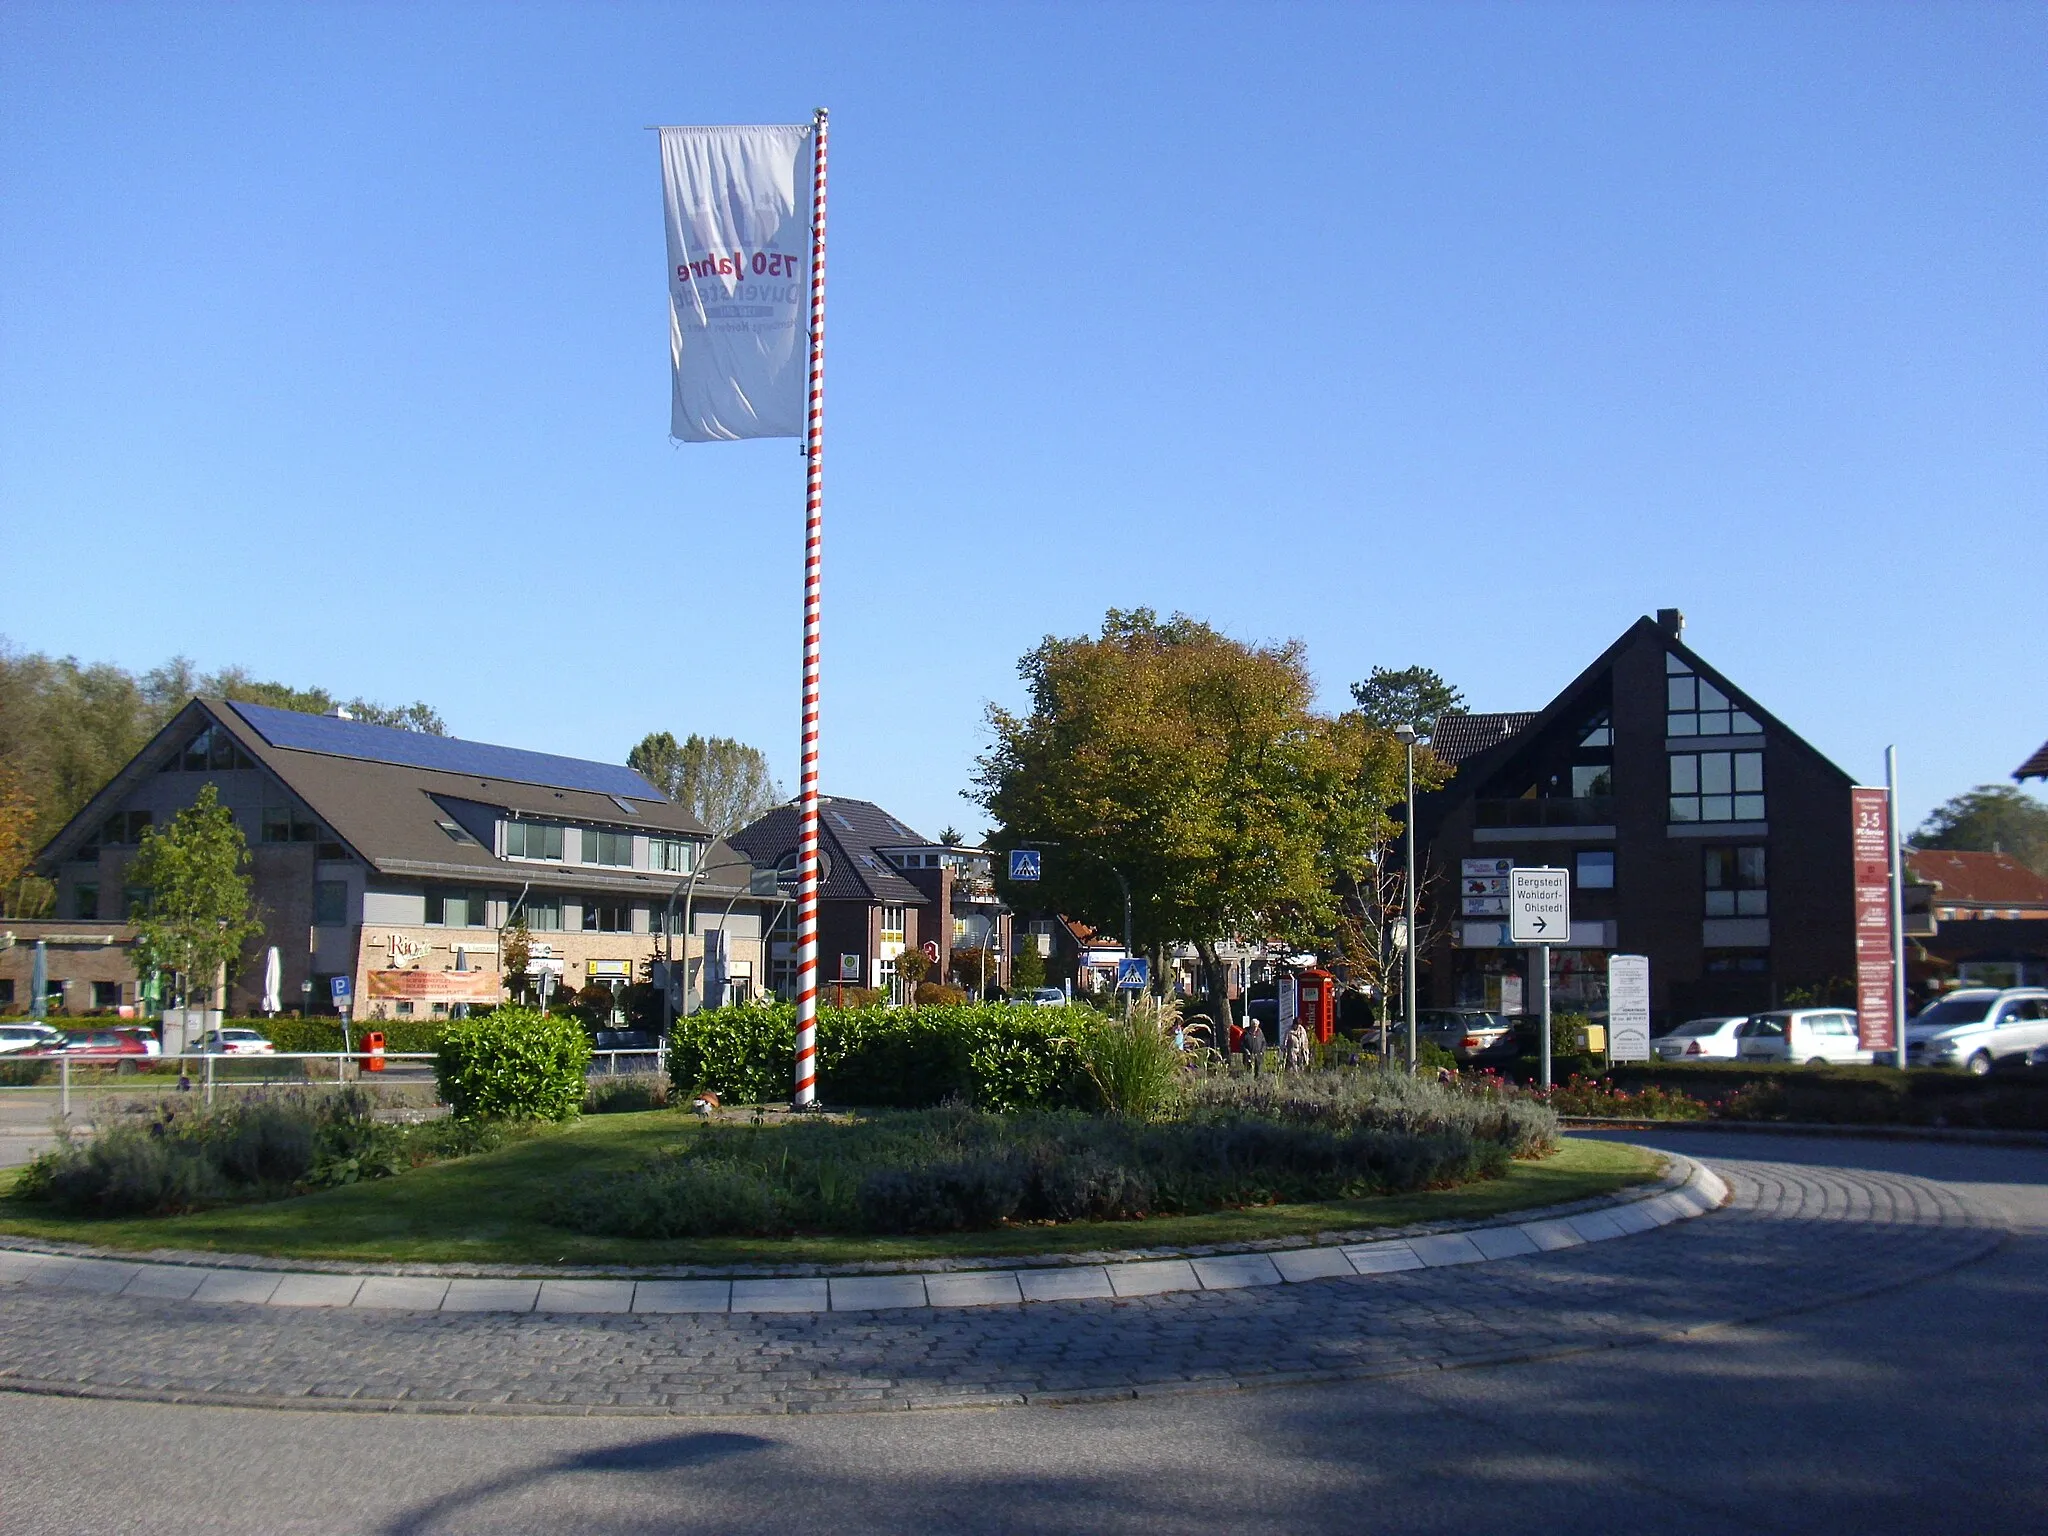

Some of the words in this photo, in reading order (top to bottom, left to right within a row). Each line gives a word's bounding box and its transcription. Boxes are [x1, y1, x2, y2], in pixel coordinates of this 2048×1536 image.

[1859, 812, 1880, 828] 3-5
[1517, 877, 1563, 889] Bergstedt
[1517, 890, 1563, 900] Wohldorf-
[1524, 903, 1563, 913] Ohlstedt
[391, 934, 419, 957] Rio
[335, 980, 346, 994] P
